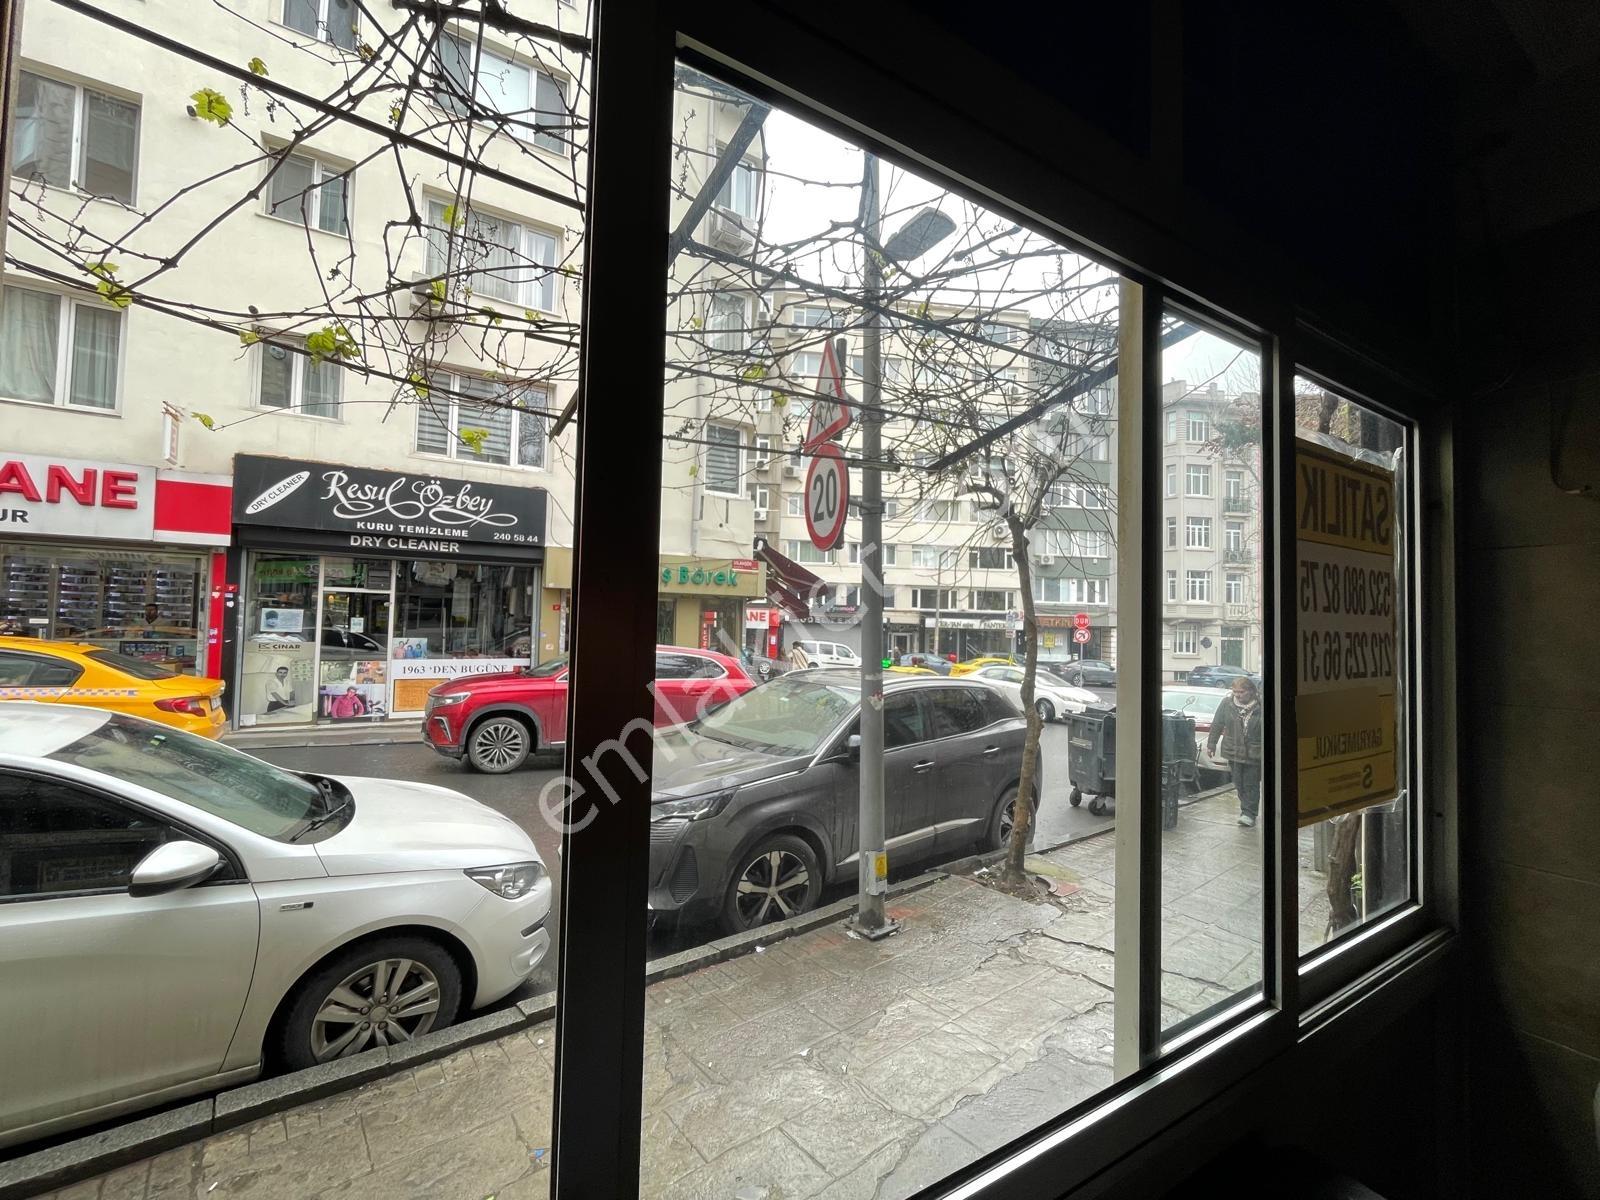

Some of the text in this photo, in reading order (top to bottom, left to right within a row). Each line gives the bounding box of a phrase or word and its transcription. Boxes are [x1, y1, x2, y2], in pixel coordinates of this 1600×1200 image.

[0, 461, 138, 509] ANE
[251, 474, 304, 511] DRY CLEANER
[321, 470, 519, 527] Resul Özbey
[813, 468, 837, 522] 20
[356, 521, 469, 537] KURU TEMİZLEME
[494, 532, 539, 543] 240 58 44
[350, 535, 460, 553] DRY CLEANER
[678, 565, 738, 586] Börek
[746, 611, 767, 621] NE
[402, 666, 426, 674] 1963
